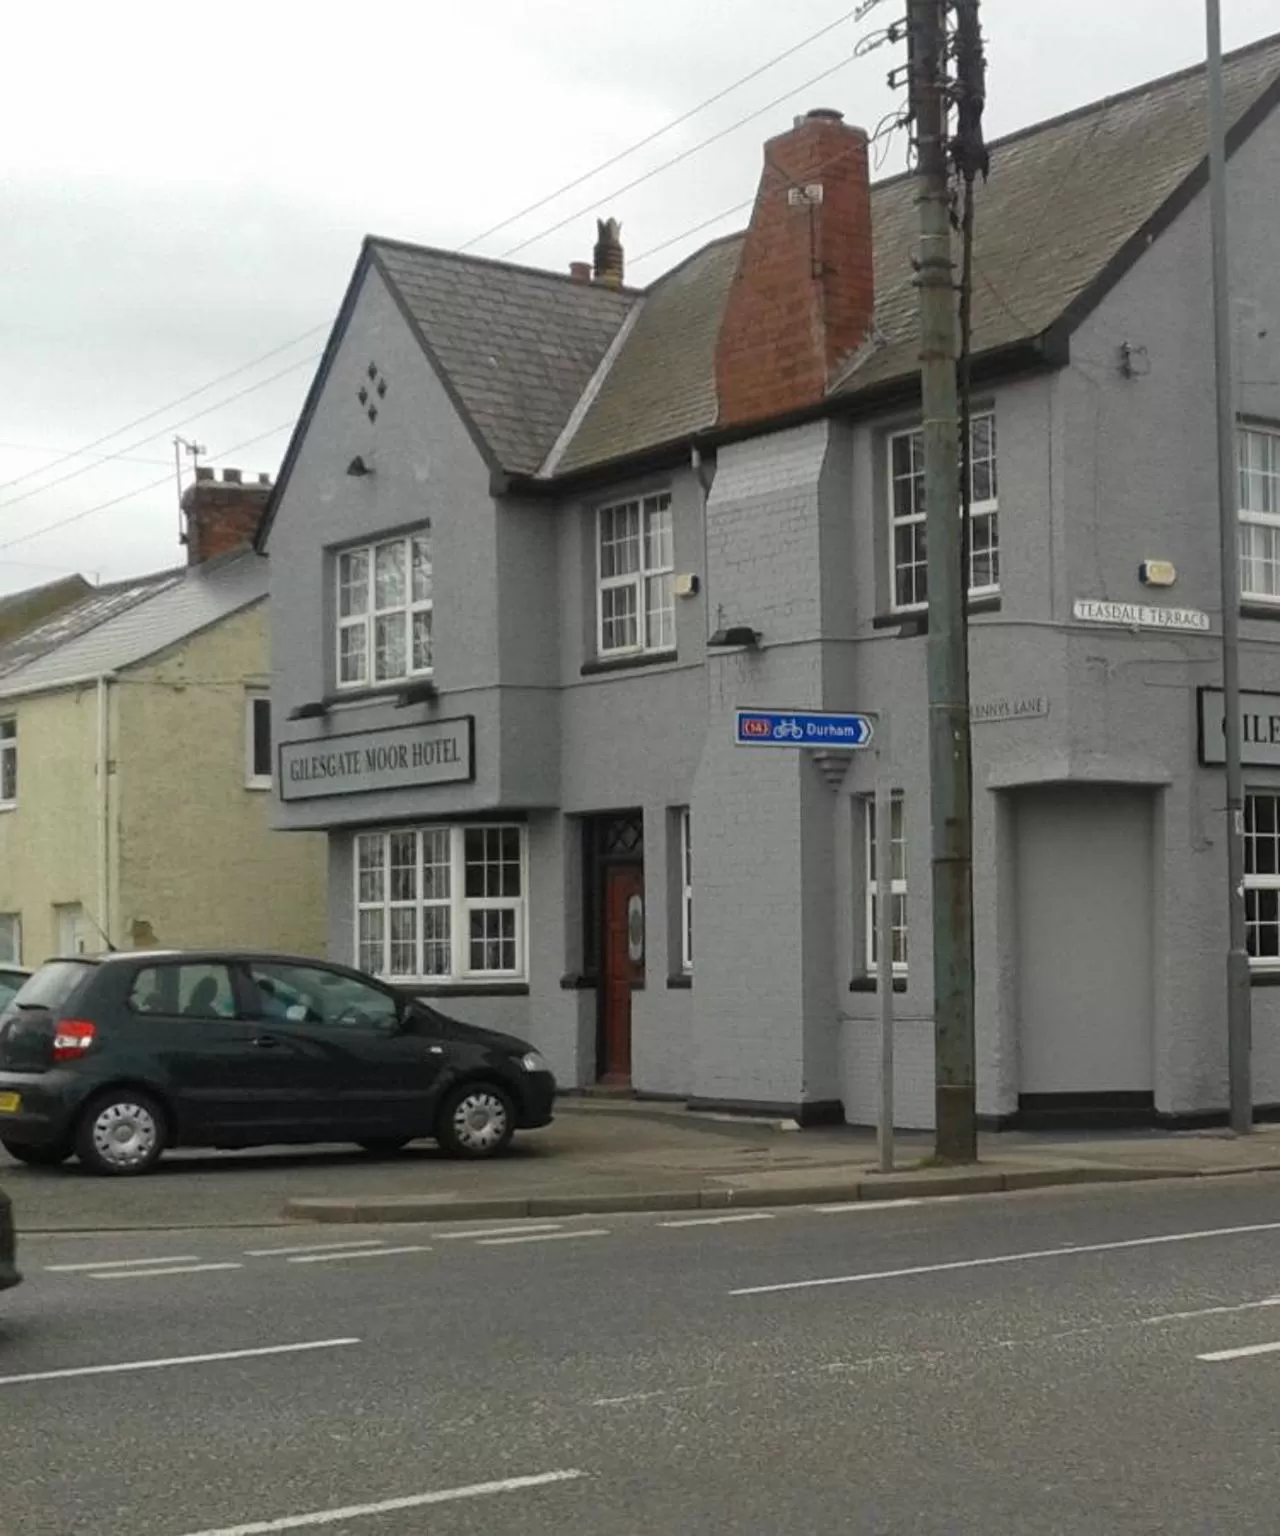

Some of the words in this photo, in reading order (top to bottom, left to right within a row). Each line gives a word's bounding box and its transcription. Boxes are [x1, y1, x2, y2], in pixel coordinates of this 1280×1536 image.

[1079, 603, 1145, 622] TEASDALE
[1150, 609, 1206, 627] TERRACE
[1013, 697, 1042, 715] LANE
[806, 722, 855, 737] Durham
[290, 750, 361, 781] GILESGATE
[363, 743, 409, 773] MOOR
[412, 737, 461, 767] HOTEL
